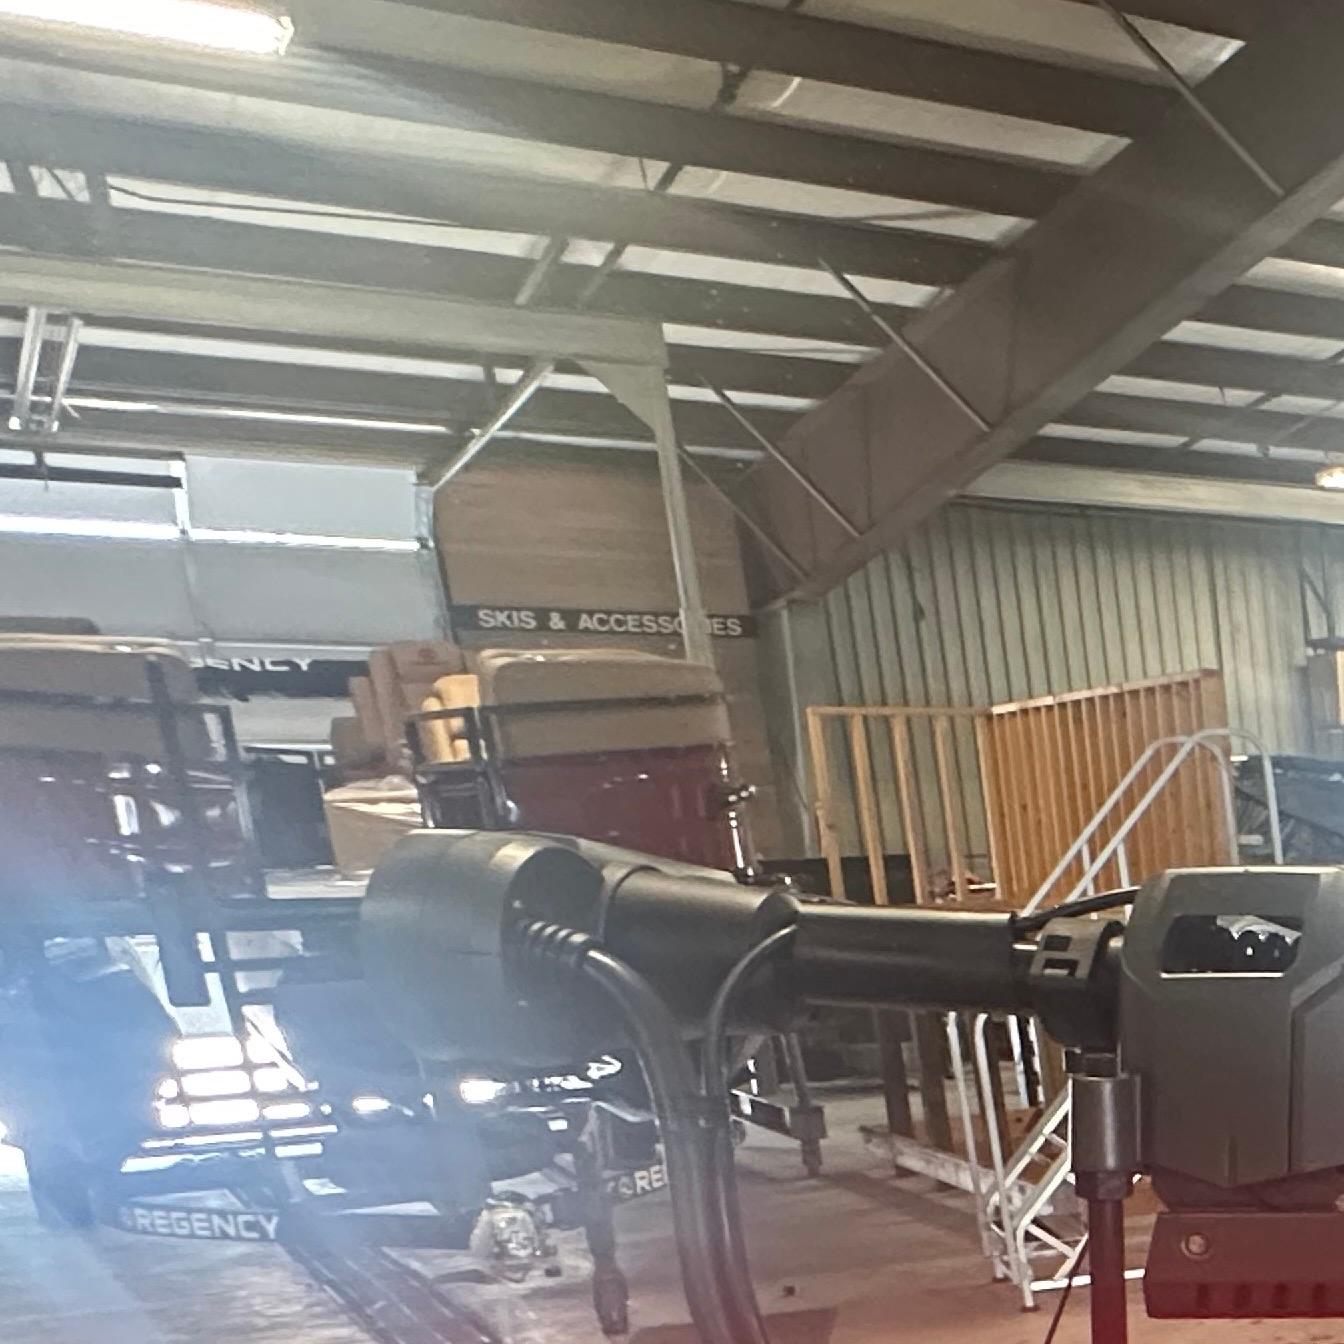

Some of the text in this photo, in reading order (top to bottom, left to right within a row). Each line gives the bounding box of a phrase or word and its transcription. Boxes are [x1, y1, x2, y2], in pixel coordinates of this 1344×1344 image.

[477, 609, 743, 636] SKIS & ACCESSIES
[133, 1207, 279, 1240] REGENCY
